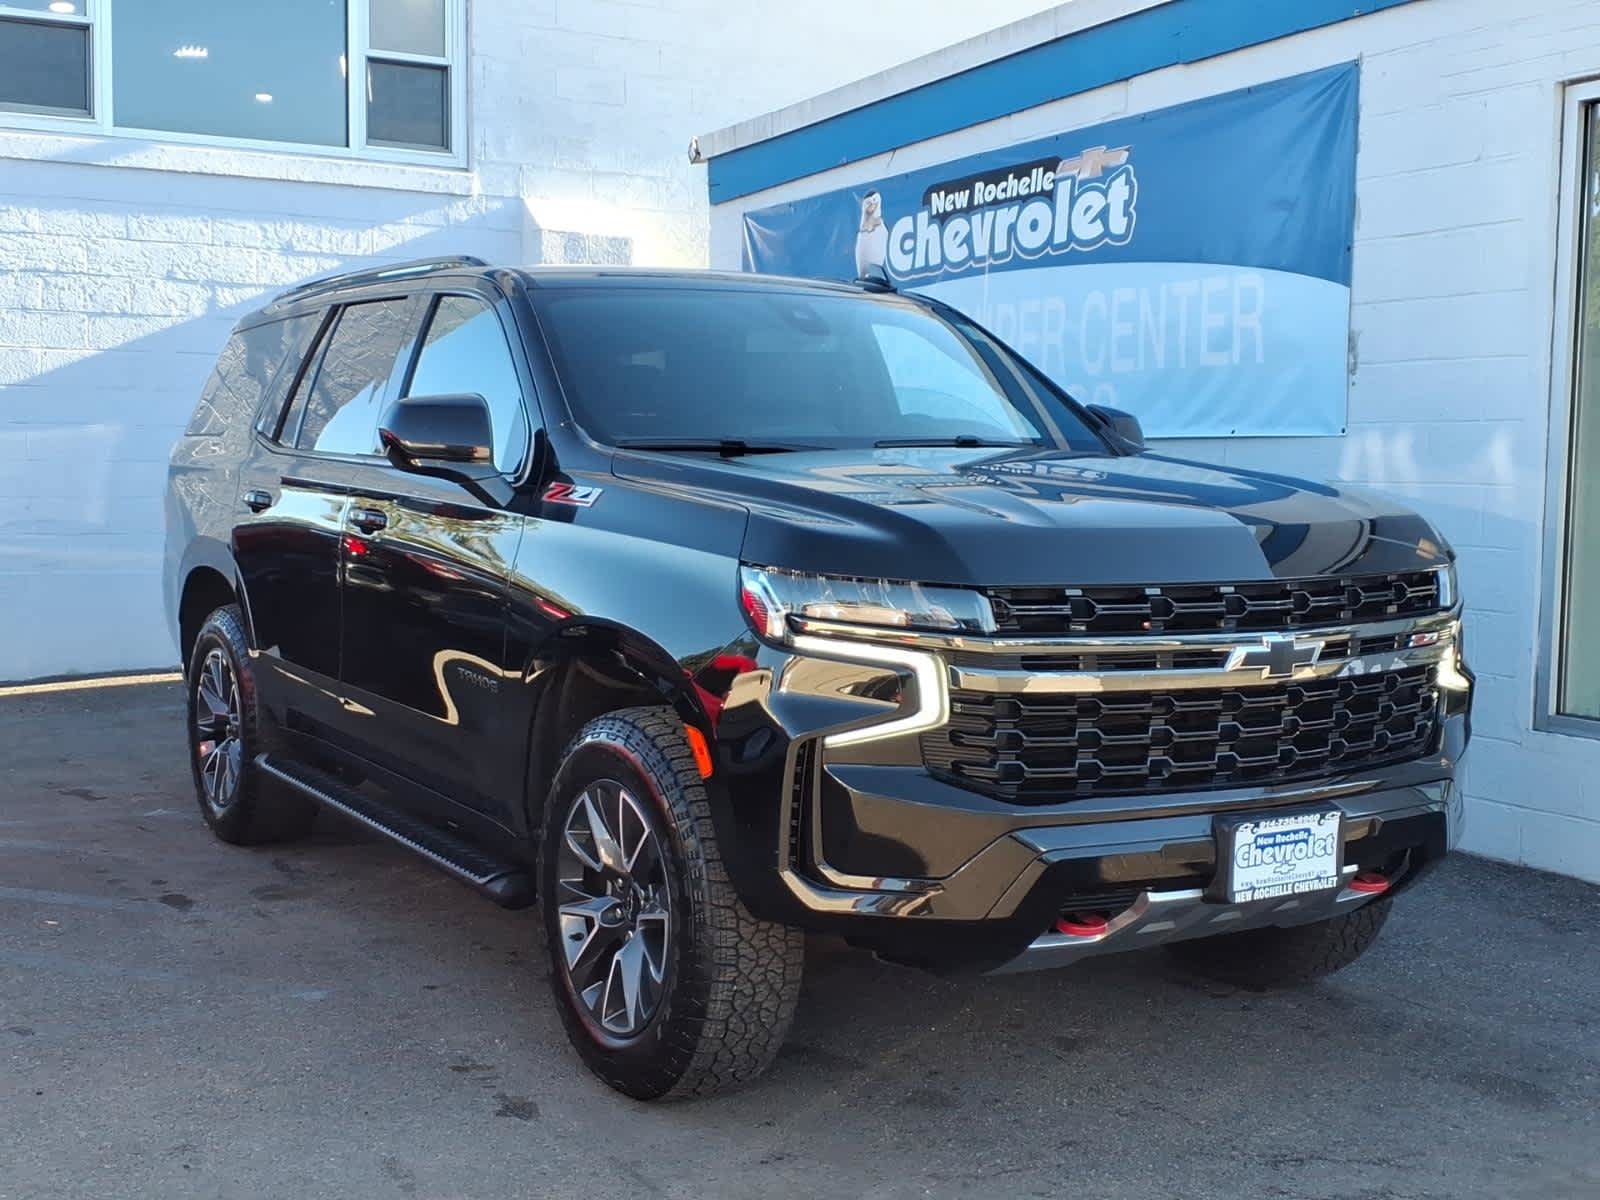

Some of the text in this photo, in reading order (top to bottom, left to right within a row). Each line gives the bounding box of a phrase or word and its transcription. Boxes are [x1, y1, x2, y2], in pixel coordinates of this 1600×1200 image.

[930, 167, 1055, 217] New Rochelle
[888, 172, 1132, 274] Chevrolet
[1080, 272, 1265, 376] CENTER
[1235, 833, 1335, 869] Chevrolet
[1256, 830, 1309, 846] New Rochelle
[1235, 876, 1338, 904] NEW ROCHELLE CHEVROLET
